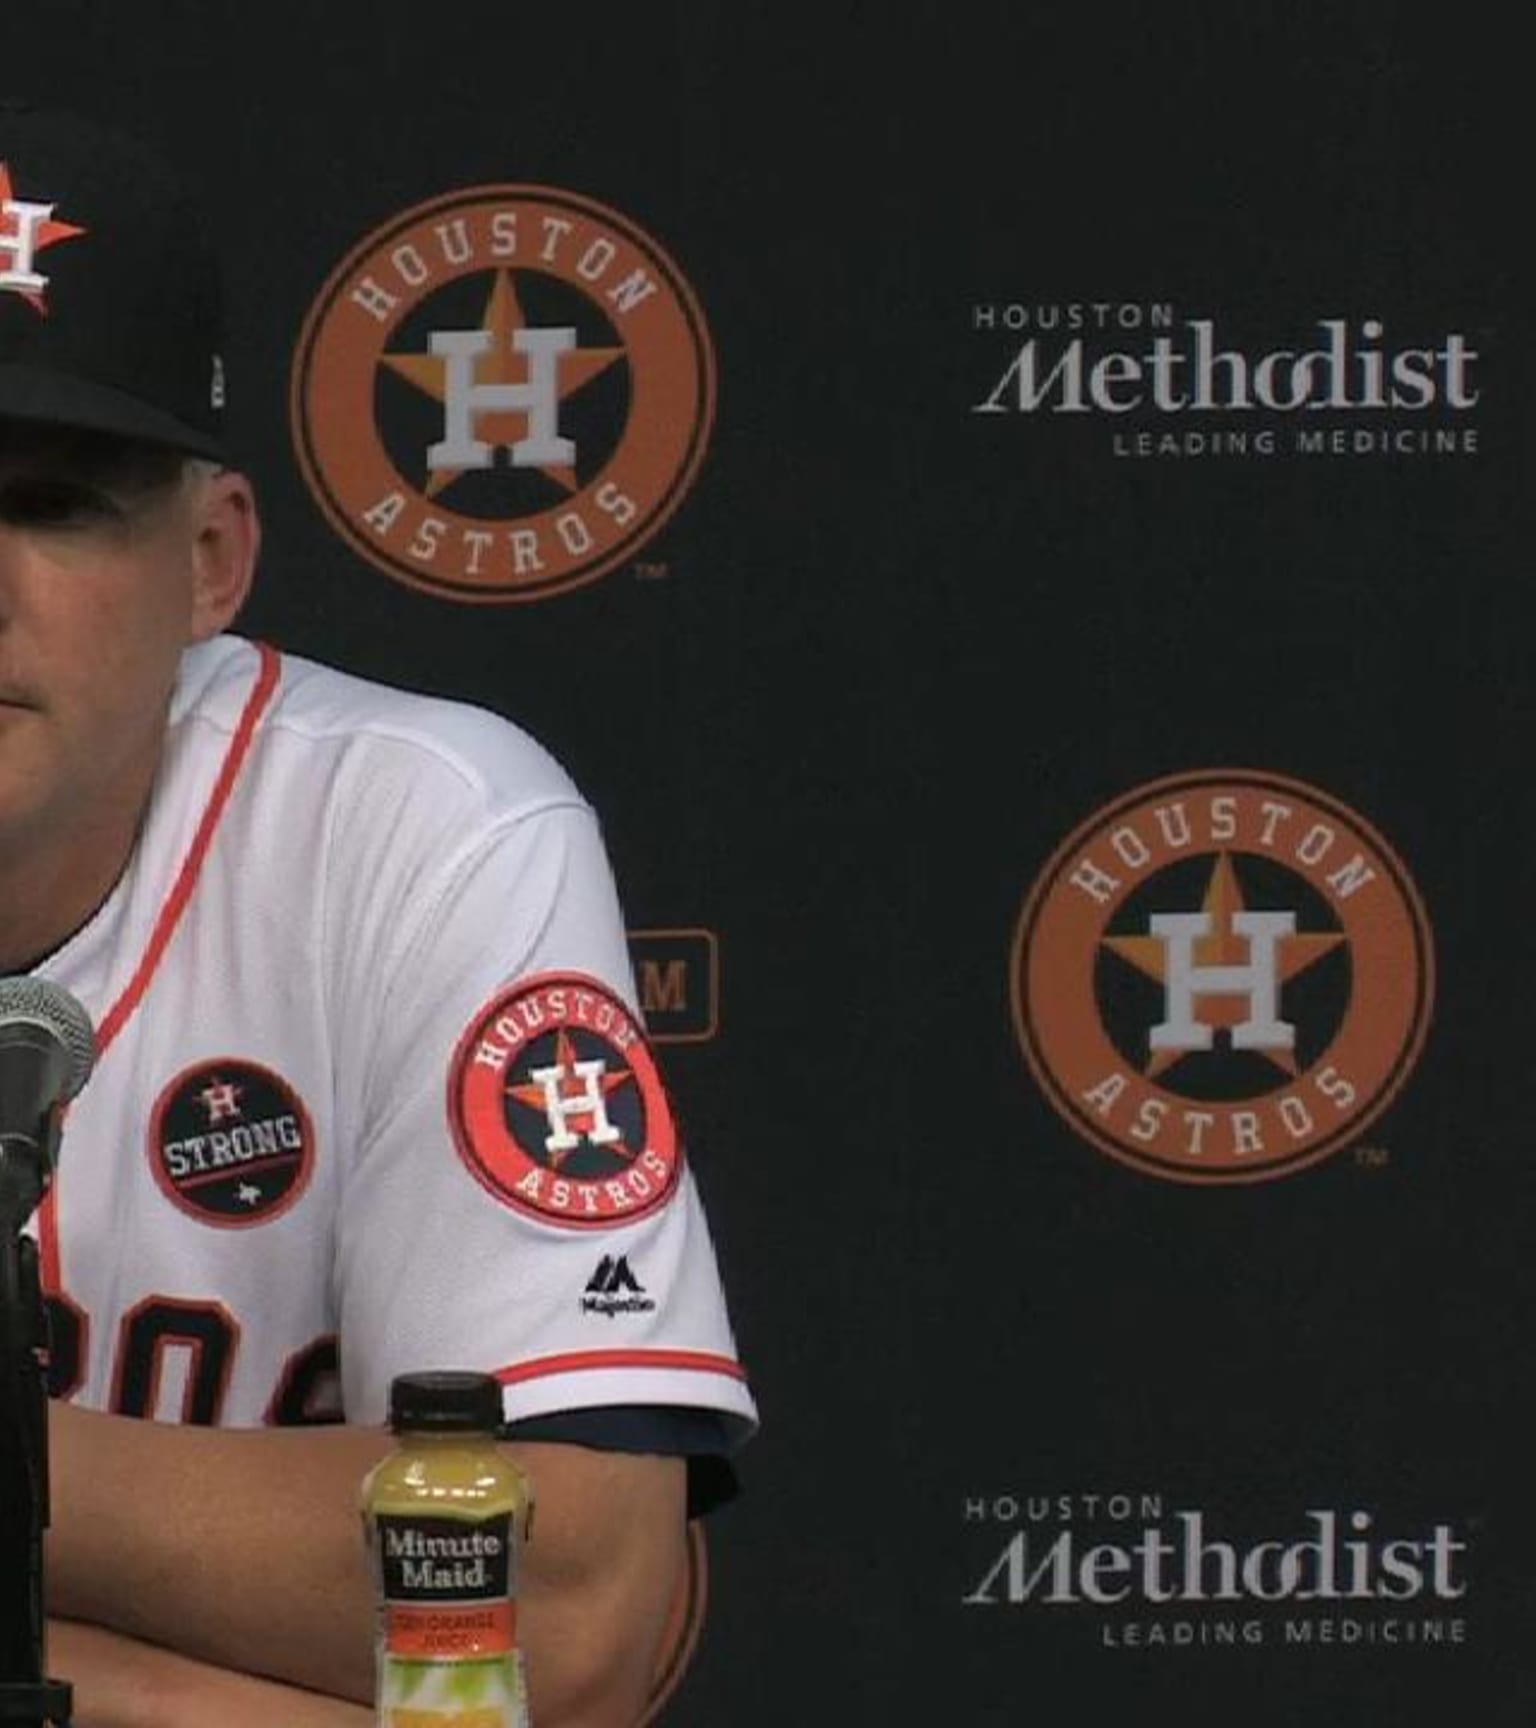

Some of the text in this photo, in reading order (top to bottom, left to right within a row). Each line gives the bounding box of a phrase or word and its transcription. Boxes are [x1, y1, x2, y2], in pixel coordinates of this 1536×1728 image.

[351, 212, 658, 322] HOUSTON
[975, 303, 1173, 330] HOUSTON
[426, 327, 577, 468] H
[973, 320, 1479, 413] Methodist
[1113, 428, 1478, 457] LEADING MEDICINE
[361, 481, 637, 575] ASTROS
[1068, 796, 1376, 904] HOUSTON
[642, 960, 686, 1011] M
[1149, 911, 1296, 1049] H
[473, 988, 637, 1071] HOUSTON
[164, 1114, 302, 1177] STRONG
[531, 1059, 620, 1152] H
[1082, 1065, 1357, 1156] ASTROS
[517, 1150, 666, 1212] ASTROS
[385, 1527, 501, 1558] Minute
[965, 1495, 1163, 1522] HOUSTON
[401, 1558, 486, 1588] Maid
[964, 1510, 1467, 1604] Methodist
[1103, 1618, 1466, 1647] LEADING MEDICINE
